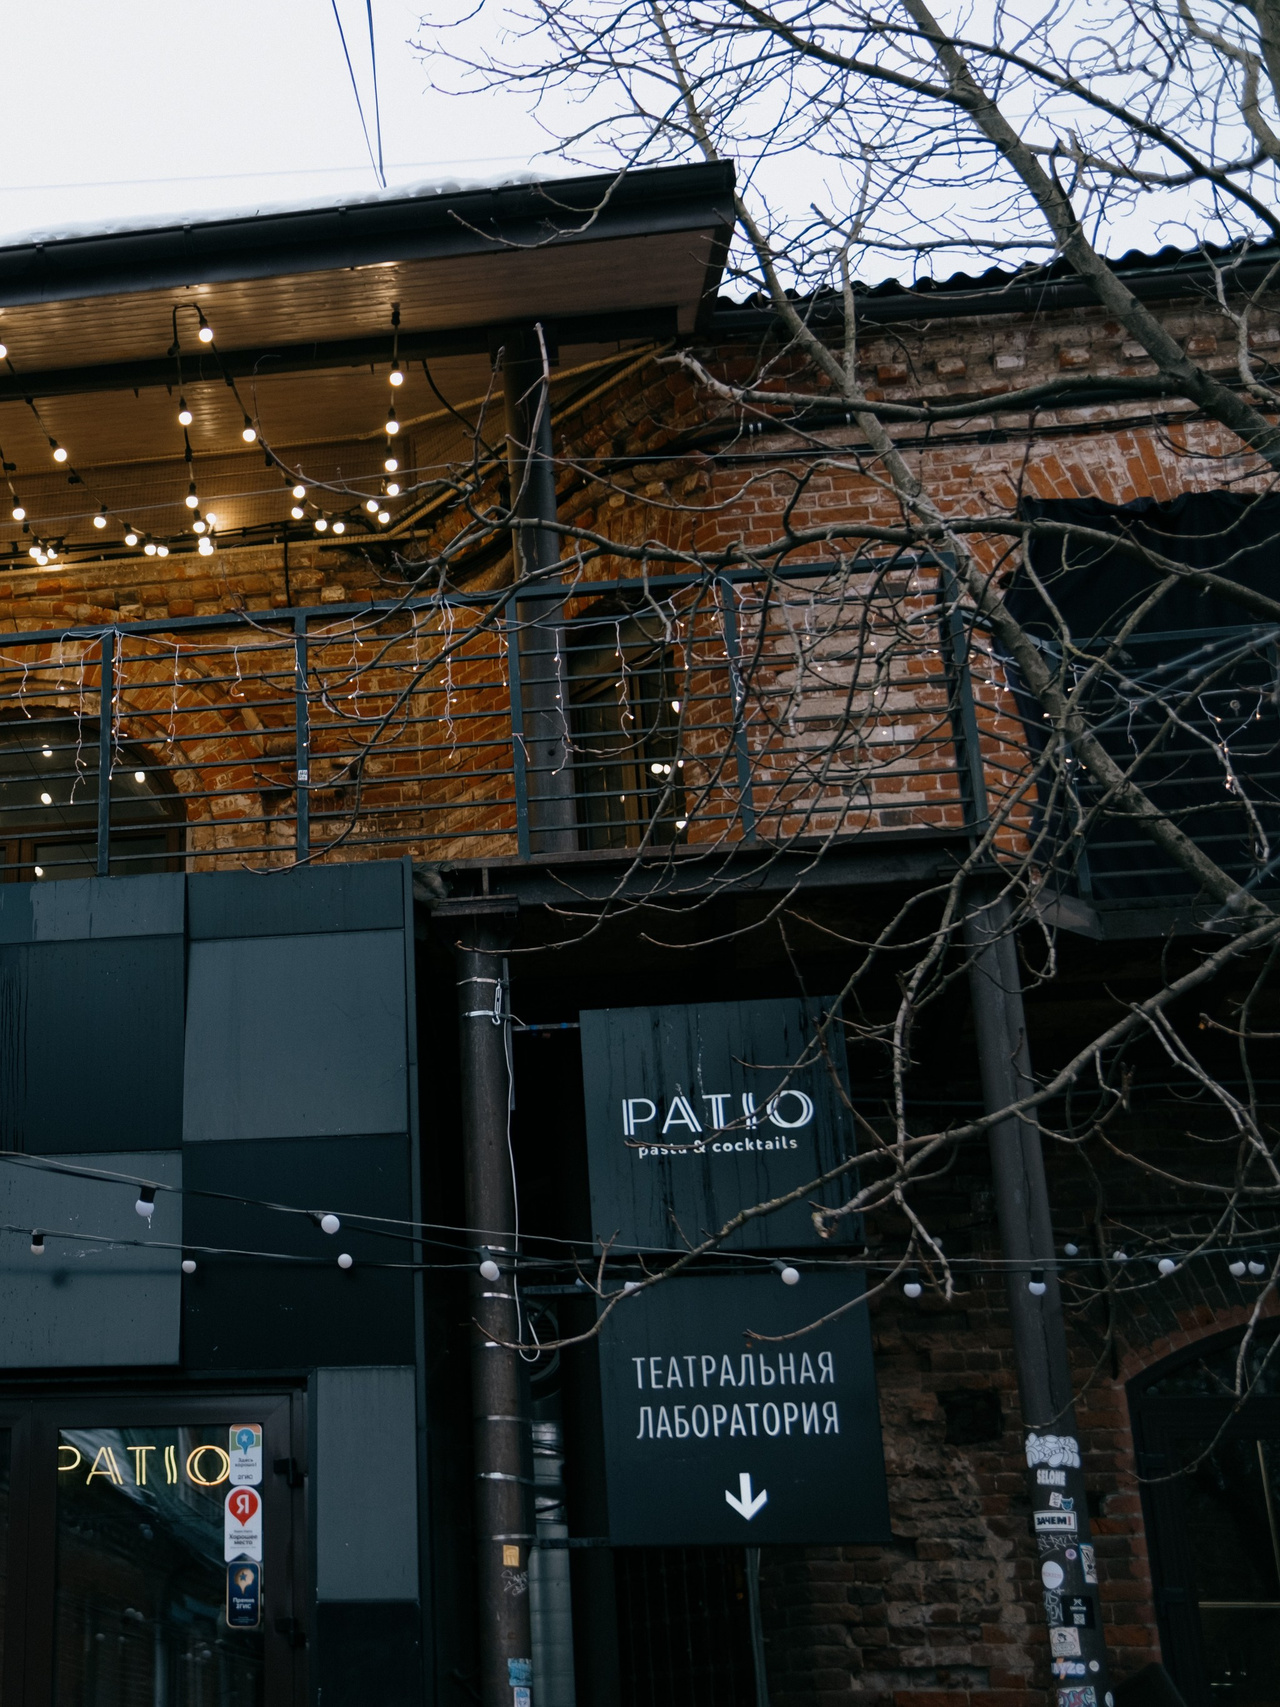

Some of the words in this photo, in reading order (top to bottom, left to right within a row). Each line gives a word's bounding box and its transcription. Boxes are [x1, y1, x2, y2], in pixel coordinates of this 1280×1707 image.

[621, 1089, 815, 1136] PATIO
[712, 1135, 799, 1154] cocktails
[632, 1351, 835, 1390] ТЕАТРАЛЬНАЯ
[636, 1400, 840, 1440] ЛАБОРАТОРИЯ
